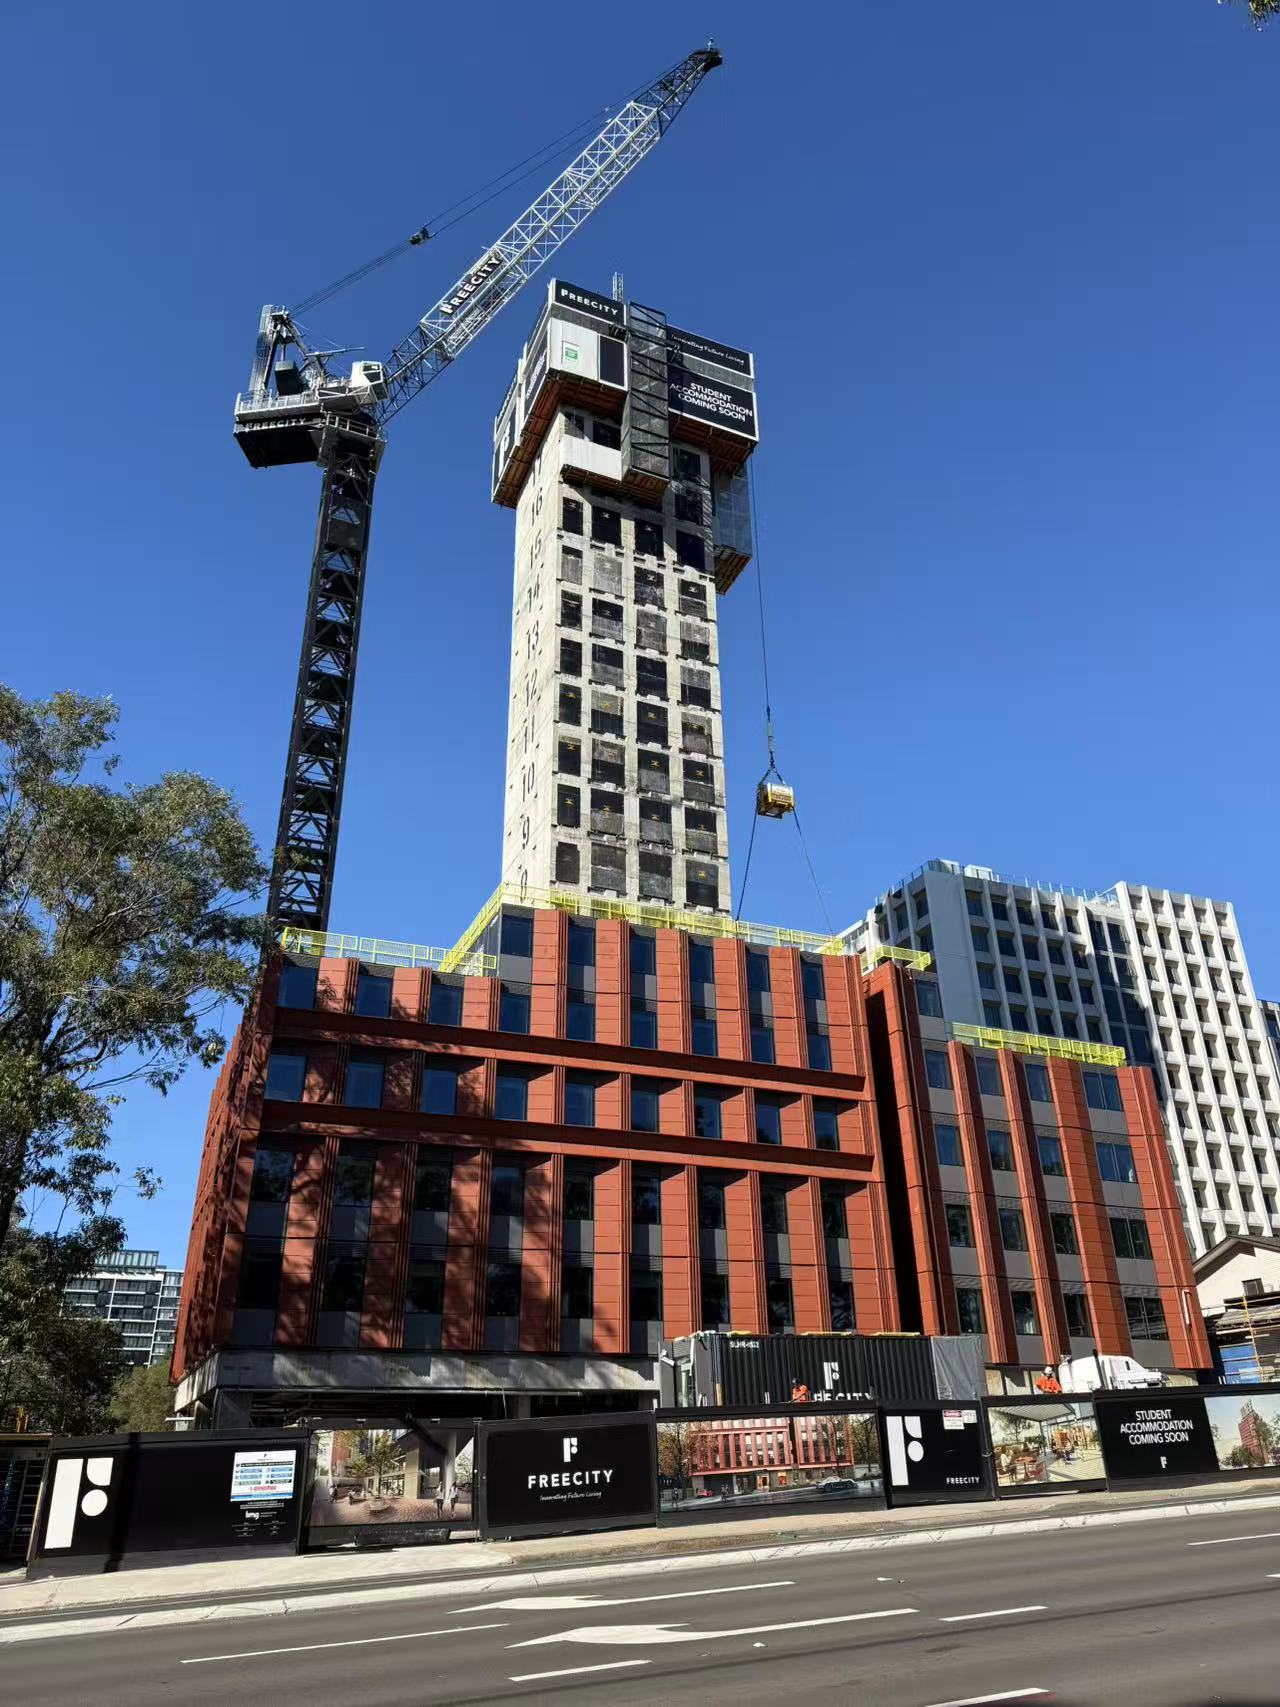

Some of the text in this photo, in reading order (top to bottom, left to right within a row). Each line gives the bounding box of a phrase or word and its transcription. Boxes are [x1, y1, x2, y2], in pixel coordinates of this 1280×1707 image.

[440, 256, 500, 314] FREECITY
[560, 288, 619, 316] FREECITY
[725, 353, 745, 366] Living
[669, 383, 753, 417] ACCOMMODATION
[678, 393, 746, 422] COMING SOON
[690, 382, 732, 402] STUDENT
[531, 487, 543, 527] 16
[530, 528, 542, 569] 15
[528, 573, 540, 614] 14
[527, 619, 539, 660] 13
[526, 668, 538, 708] 12
[524, 714, 535, 754] 11
[522, 761, 535, 802] 10
[522, 816, 530, 850] 9
[1119, 1420, 1194, 1434] ACCOMMODATION
[1135, 1409, 1172, 1421] STUDENT
[1128, 1431, 1189, 1446] COMING SOON
[527, 1469, 613, 1490] FREECITY
[945, 1476, 980, 1485] FREECITY
[539, 1491, 602, 1502] Innovating Future Living
